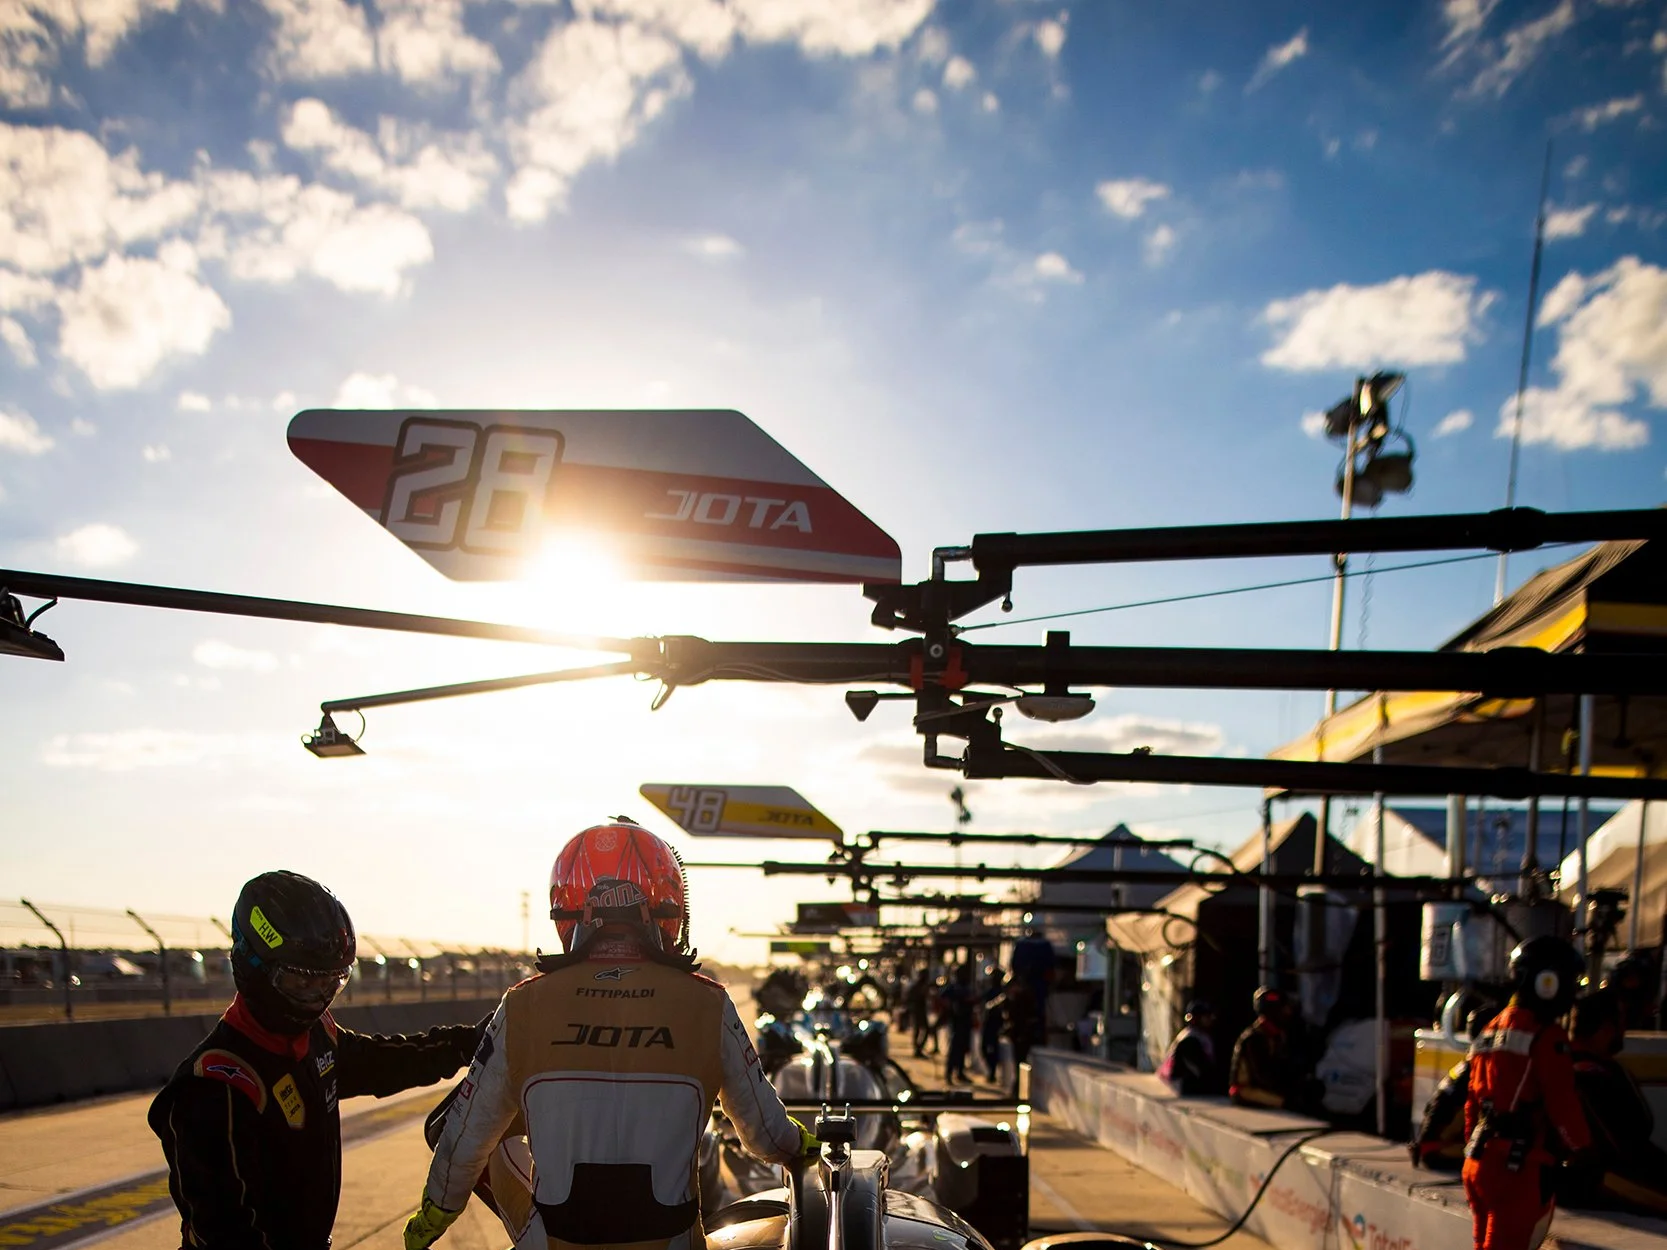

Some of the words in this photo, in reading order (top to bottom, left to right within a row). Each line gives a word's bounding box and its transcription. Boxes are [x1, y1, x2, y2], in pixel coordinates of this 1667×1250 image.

[381, 416, 565, 554] 28
[644, 489, 813, 534] JOTA
[668, 785, 728, 833] 48
[575, 987, 655, 999] FITTIPALDI
[551, 1023, 675, 1050] JOTA
